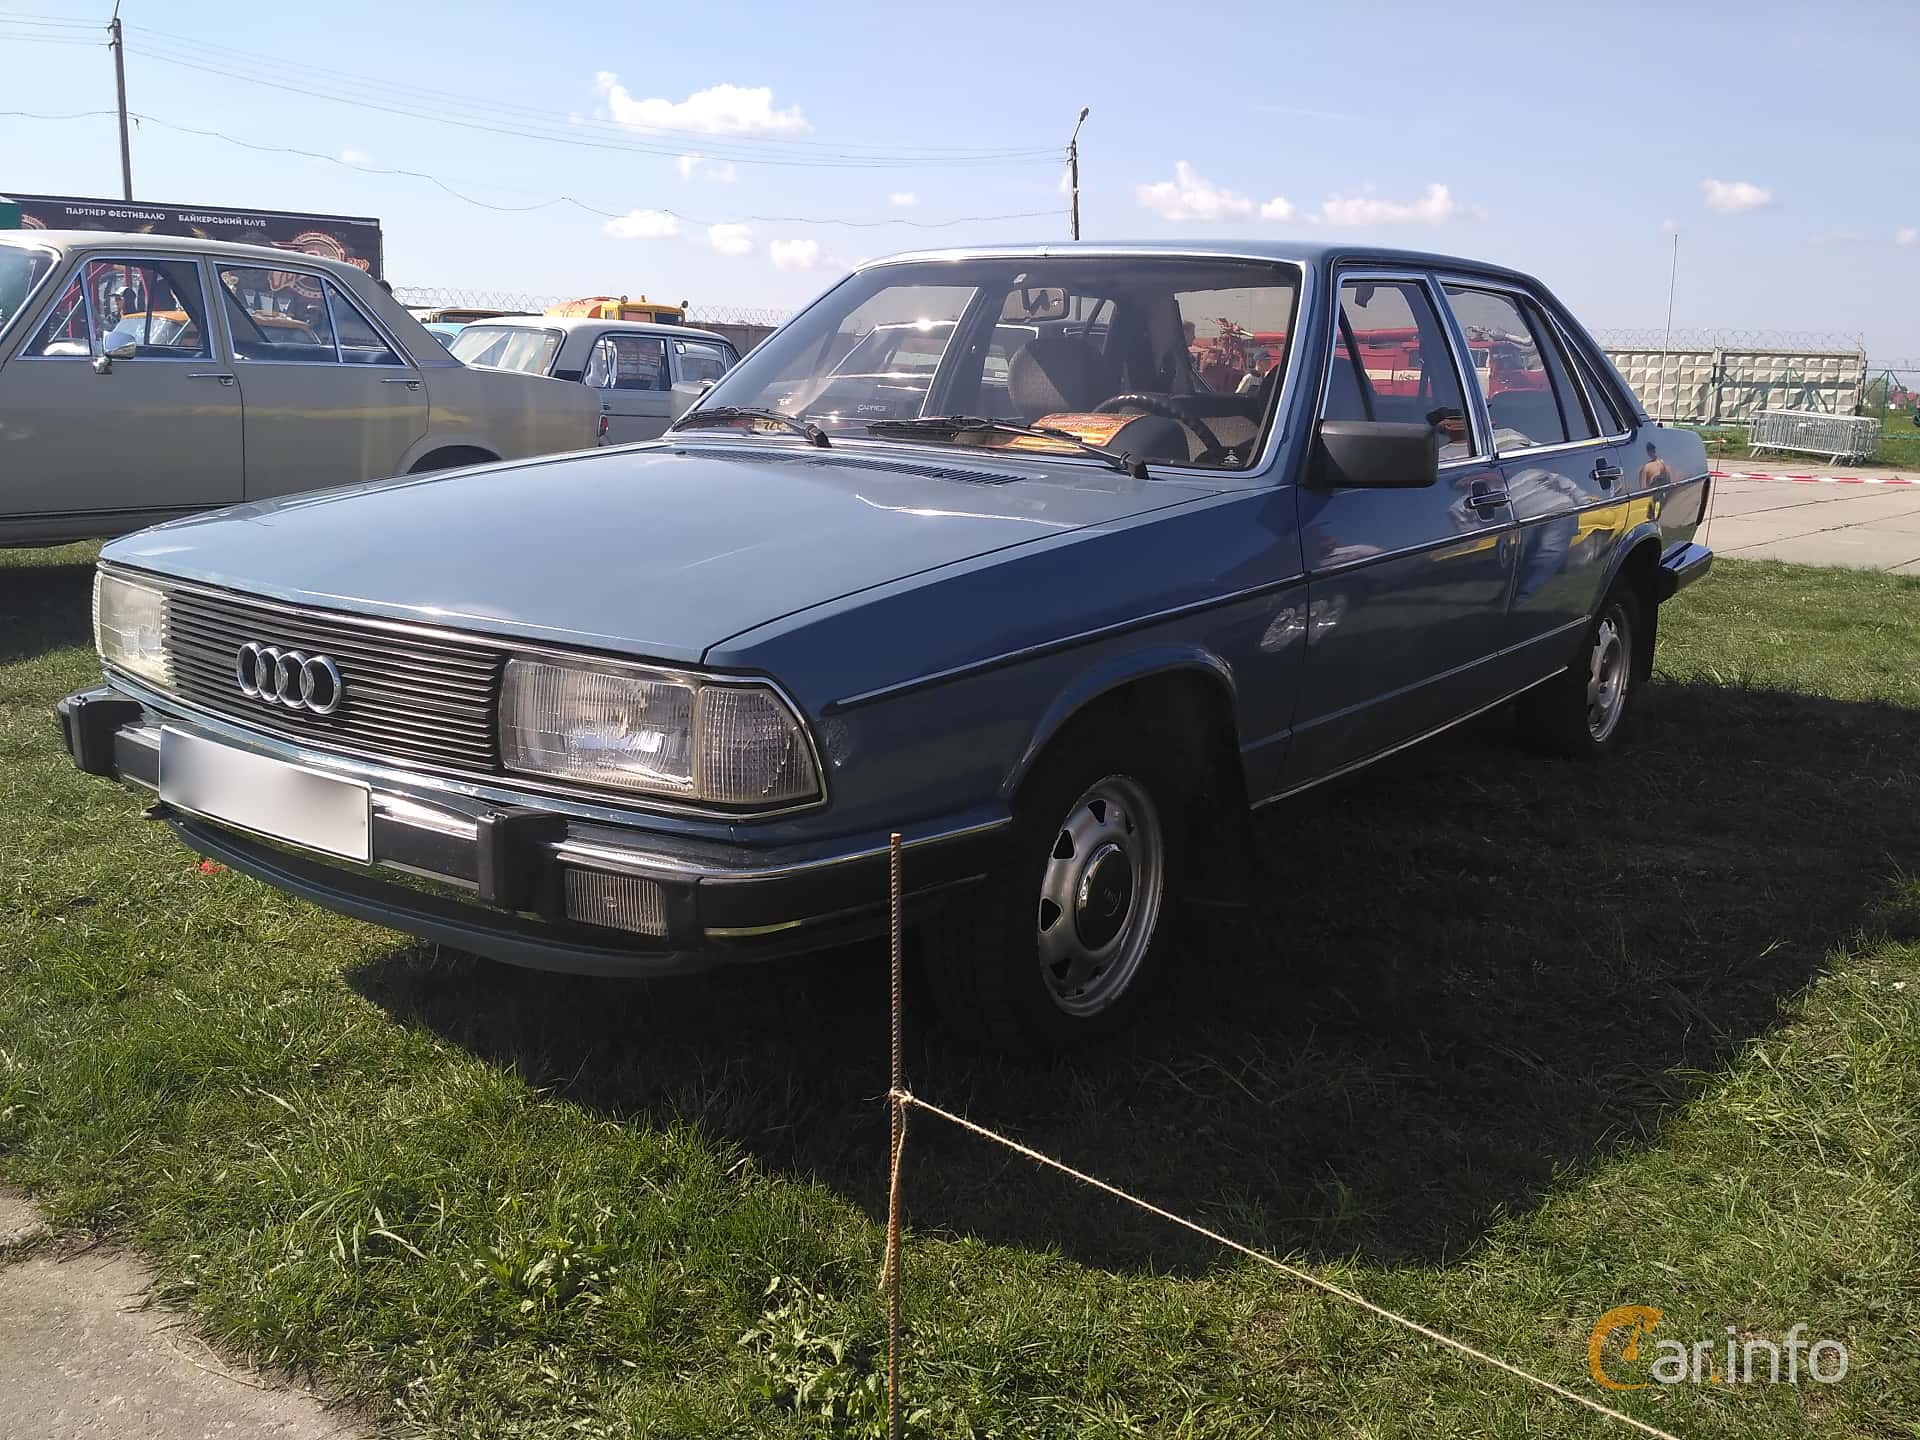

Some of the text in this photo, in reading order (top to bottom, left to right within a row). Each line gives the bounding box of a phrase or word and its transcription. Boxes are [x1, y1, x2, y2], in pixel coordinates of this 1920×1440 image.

[65, 207, 166, 221] ПАРТНЕР ФЕСТИВАЛЮ
[178, 213, 267, 228] БАЙКЕРСЬКИЙ КЛУБ
